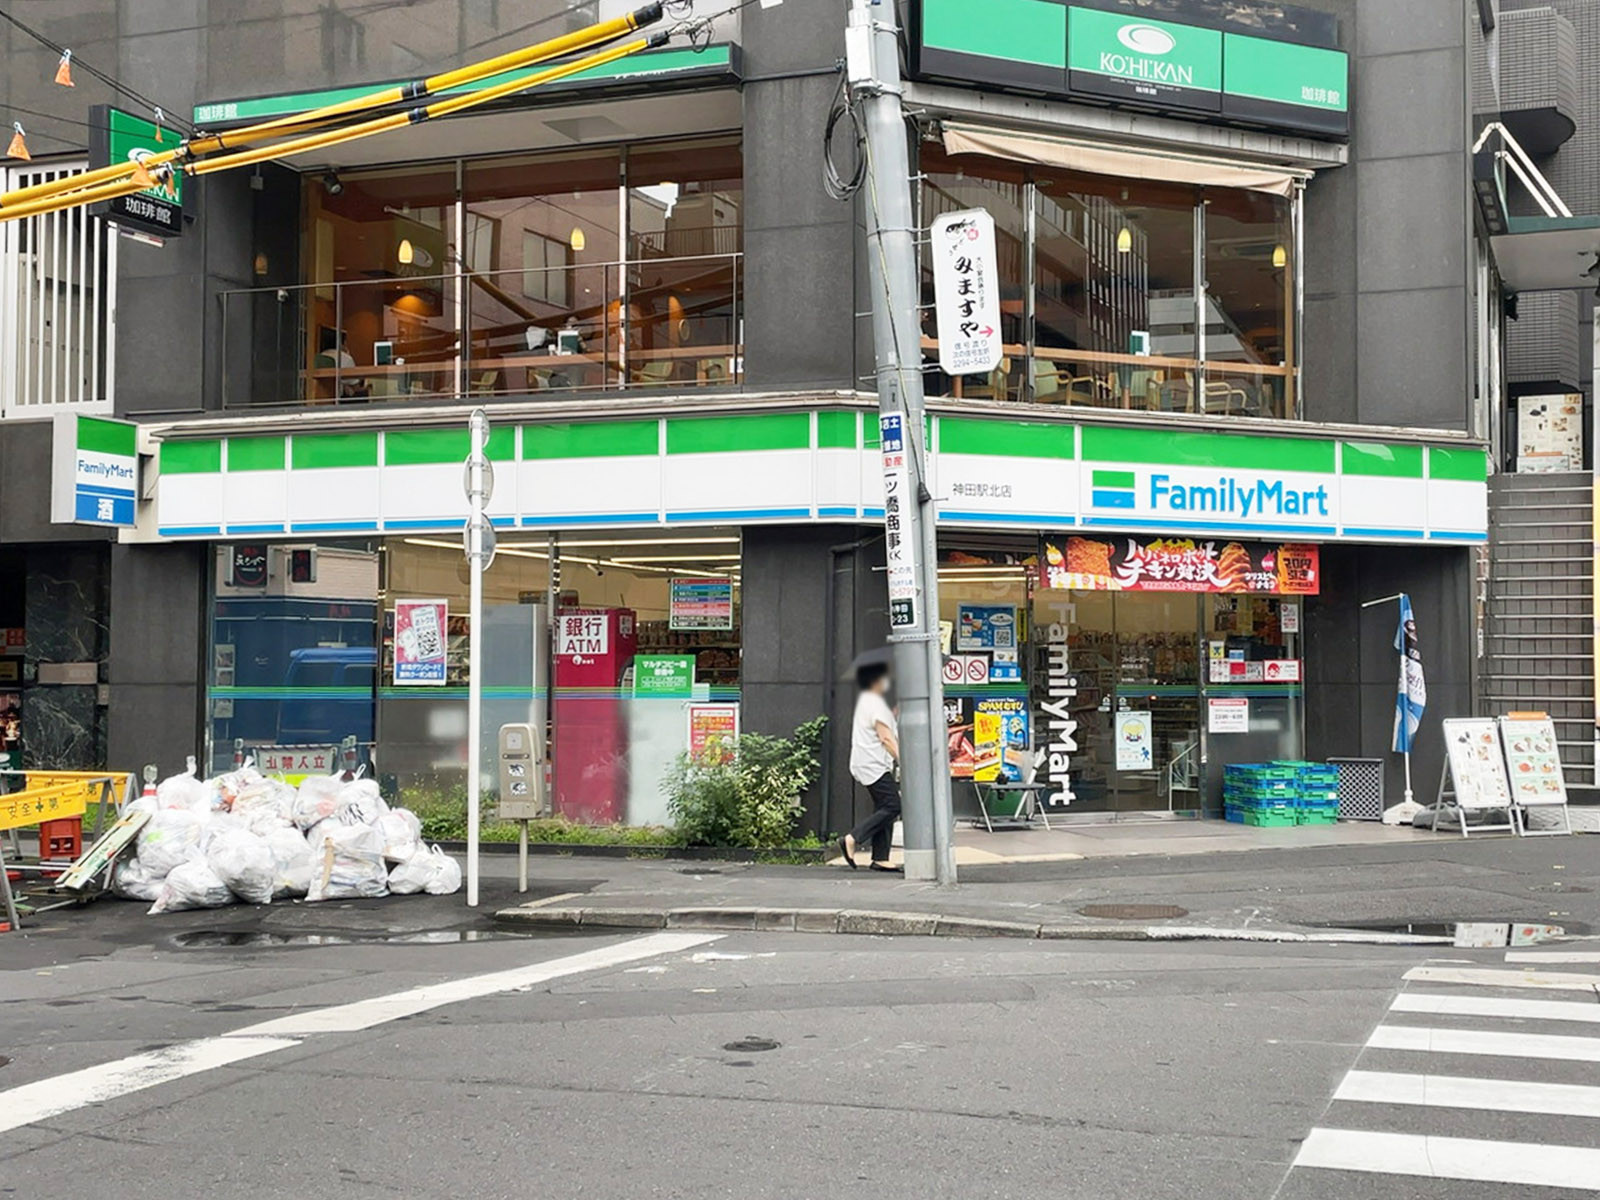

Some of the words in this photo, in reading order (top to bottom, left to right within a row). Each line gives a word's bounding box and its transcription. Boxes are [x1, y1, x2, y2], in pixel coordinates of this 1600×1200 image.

[1301, 86, 1340, 105] 珈琲館
[198, 104, 238, 120] 珈琲館
[125, 197, 171, 224] 珈琲館
[954, 256, 979, 338] みますや
[78, 459, 134, 478] FamilyMart
[952, 483, 1012, 498] 神田駅北店
[1149, 474, 1329, 518] FamilyMart
[97, 498, 114, 522] 酒
[1113, 556, 1233, 589] チキン対決
[566, 617, 602, 637] 銀行
[566, 639, 601, 653] ATM
[1041, 603, 1078, 806] FamilyMart
